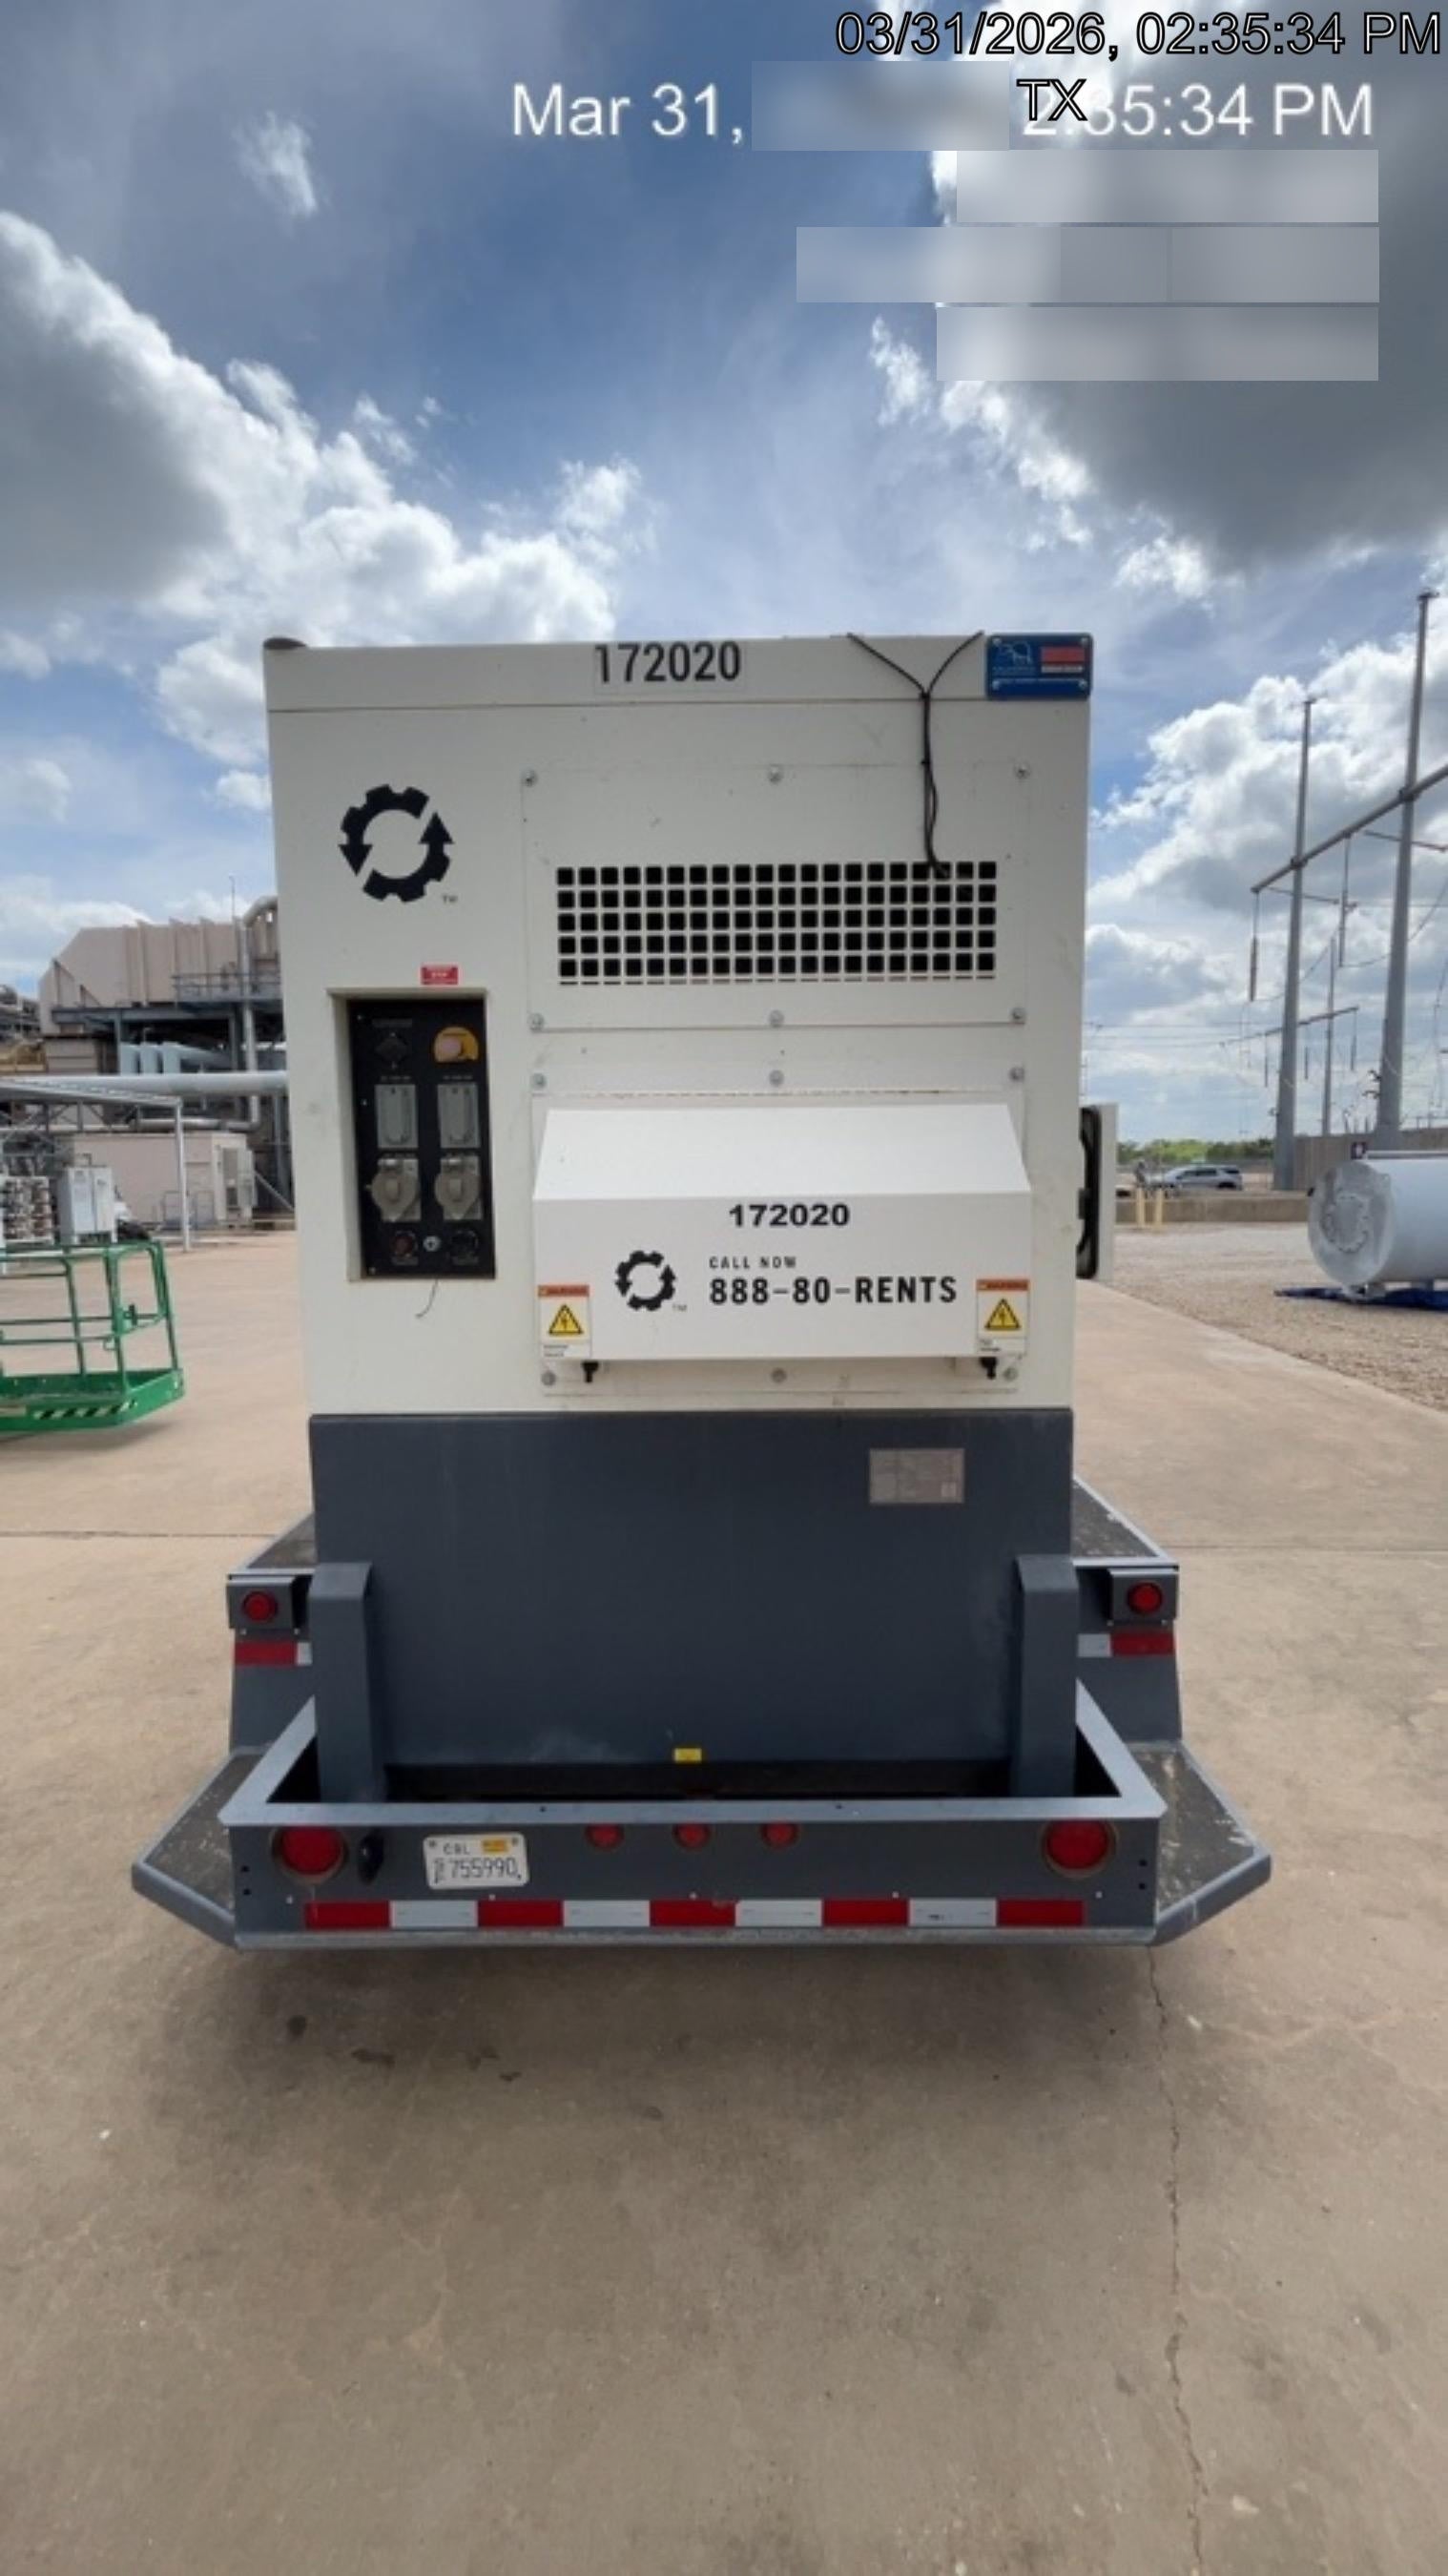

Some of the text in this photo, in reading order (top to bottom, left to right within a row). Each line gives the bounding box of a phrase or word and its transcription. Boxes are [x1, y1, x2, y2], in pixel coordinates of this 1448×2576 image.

[594, 641, 741, 684] 172020
[729, 1203, 851, 1227] 172020
[709, 1256, 797, 1269] CALL NOW
[709, 1276, 958, 1305] 888-80-RENTS
[449, 1857, 518, 1879] 755990
